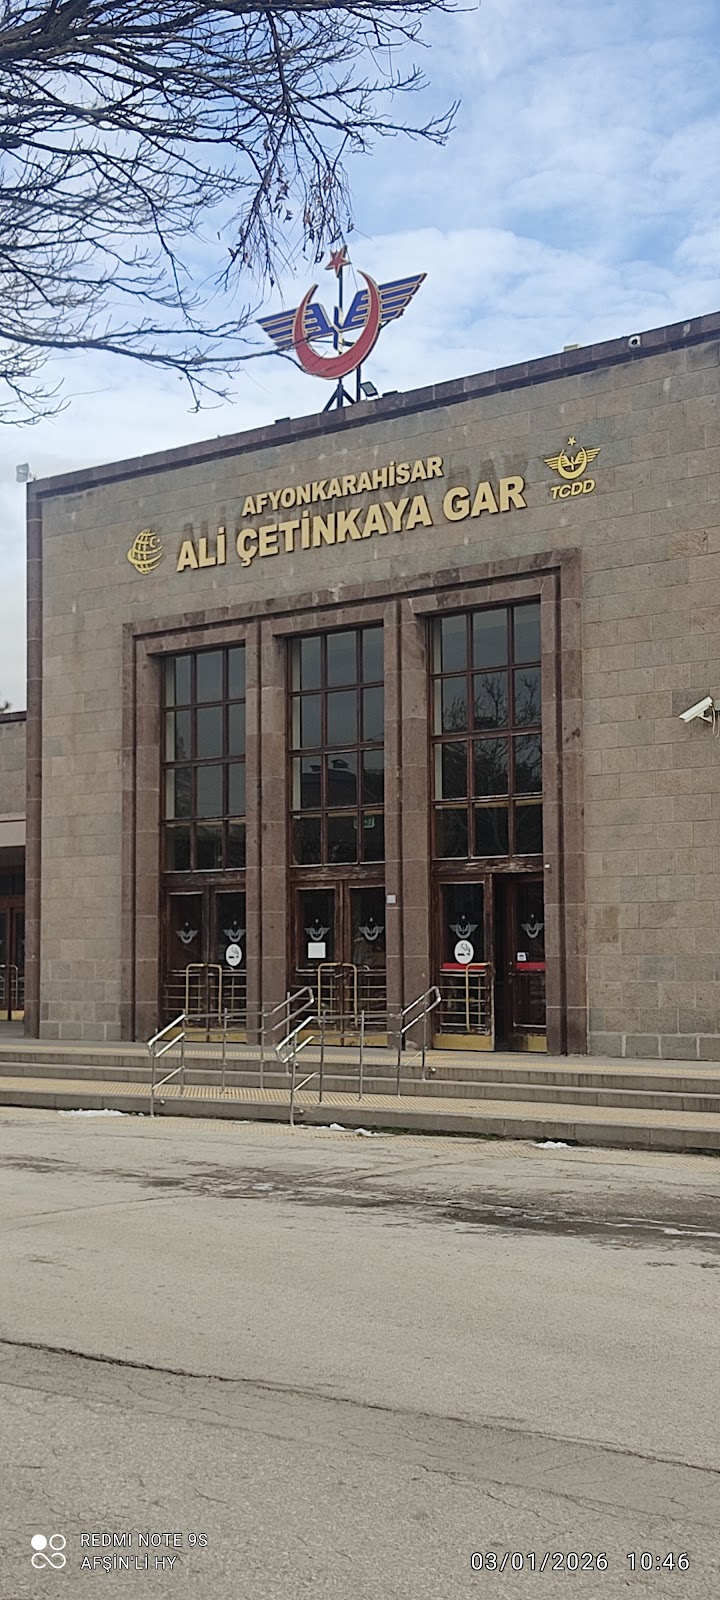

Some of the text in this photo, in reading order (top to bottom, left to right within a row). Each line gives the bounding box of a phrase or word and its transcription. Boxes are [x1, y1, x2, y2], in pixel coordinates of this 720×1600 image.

[241, 456, 444, 517] AFYONKARAHİSAR
[550, 479, 596, 500] TCDD
[176, 475, 527, 572] ALİ ÇETİNKAYA GAR
